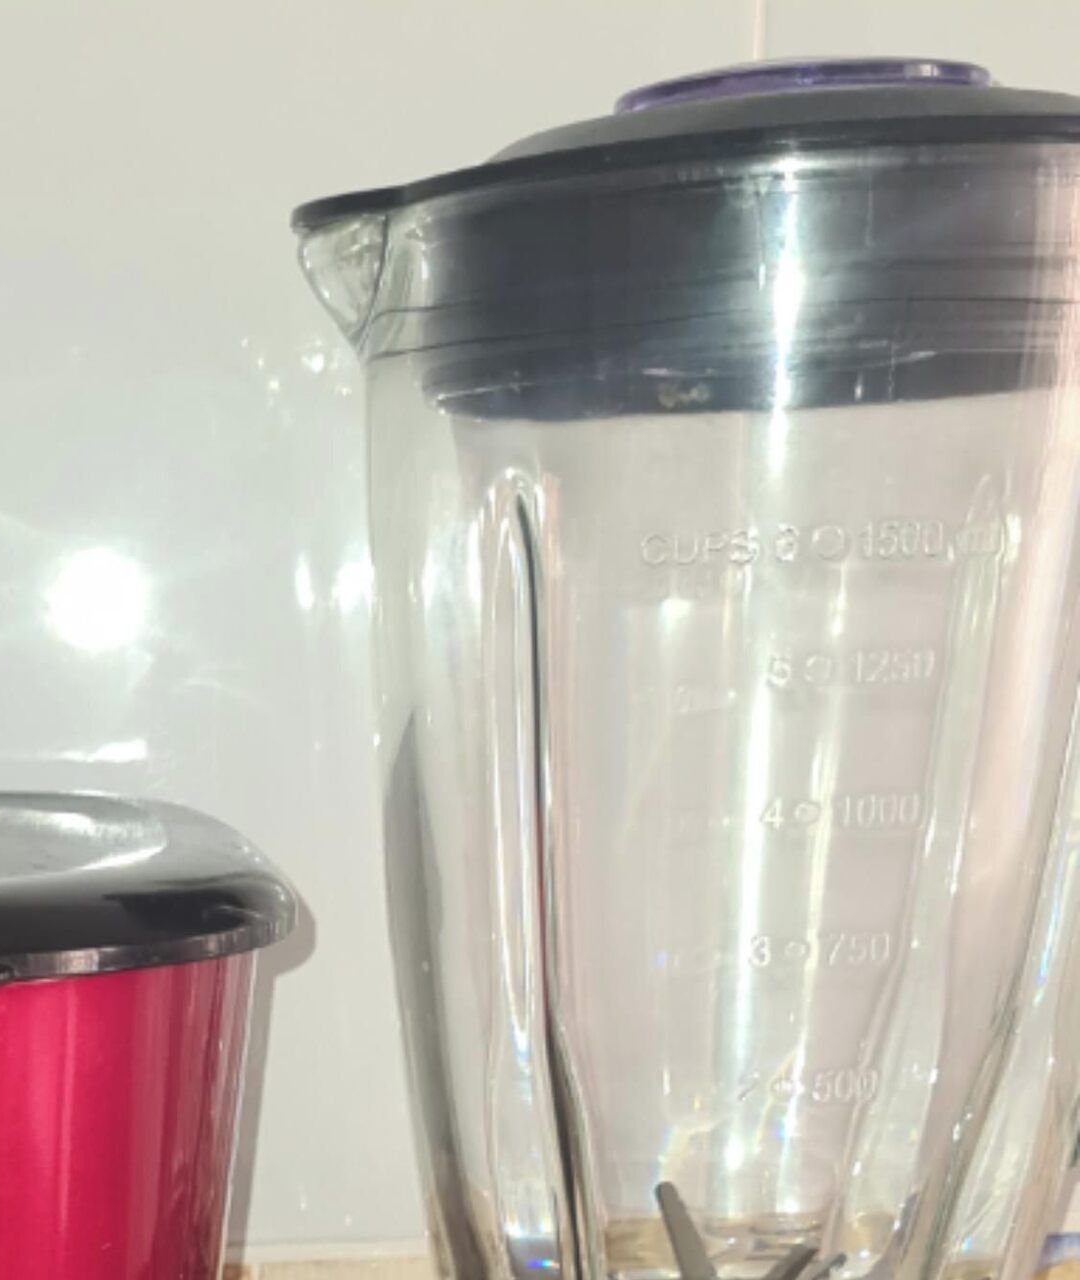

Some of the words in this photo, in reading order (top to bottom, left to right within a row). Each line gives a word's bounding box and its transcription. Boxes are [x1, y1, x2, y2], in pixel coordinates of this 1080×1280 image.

[640, 525, 760, 567] CUPS
[862, 519, 943, 561] 1500
[853, 649, 936, 684] 1250
[760, 797, 784, 829] 4
[837, 795, 920, 828] 1000
[749, 934, 771, 967] 3
[828, 932, 891, 966] 750
[810, 1069, 878, 1102] 500
